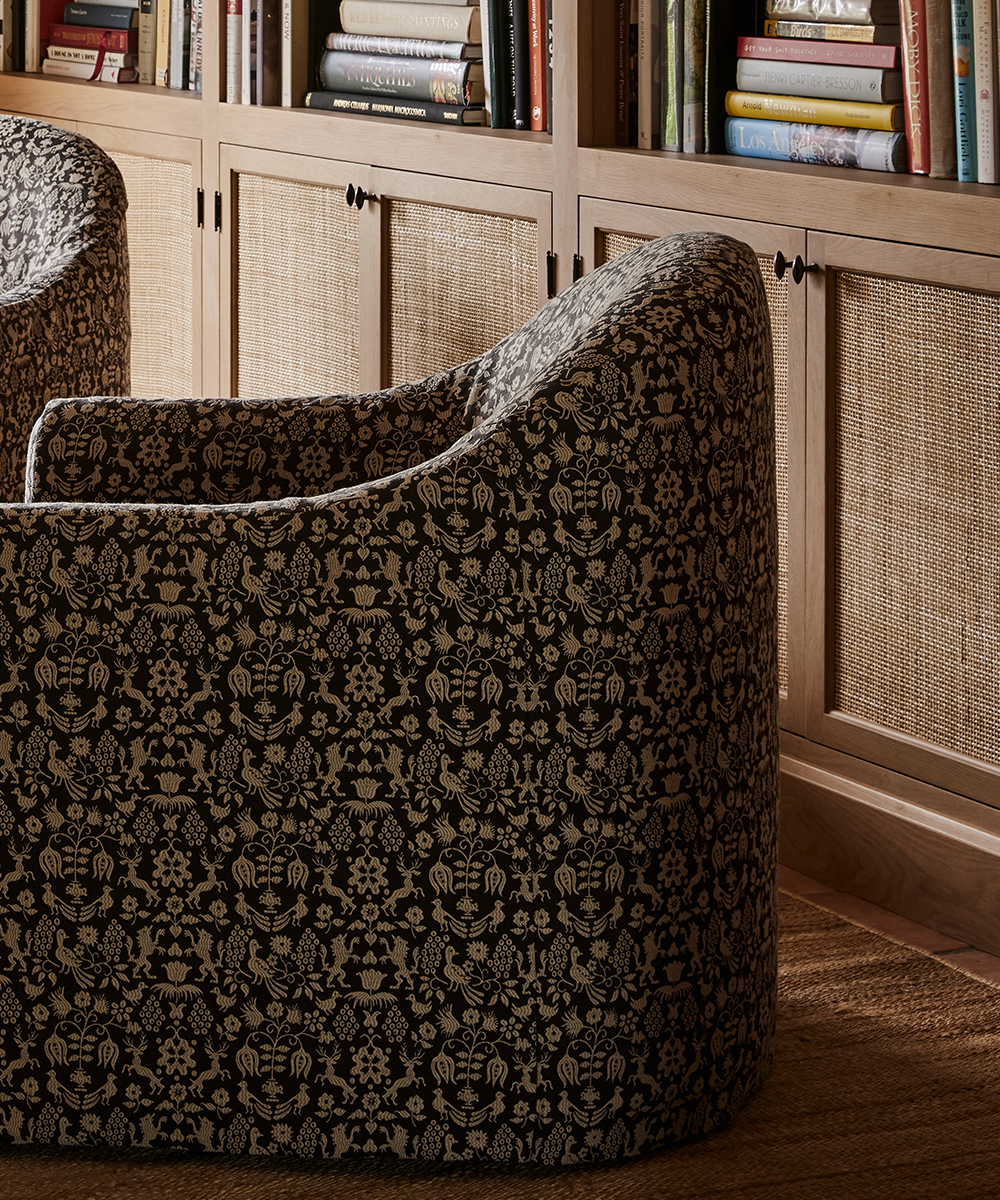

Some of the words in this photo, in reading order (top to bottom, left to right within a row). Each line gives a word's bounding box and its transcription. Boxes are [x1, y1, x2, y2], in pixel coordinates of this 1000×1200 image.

[791, 25, 813, 37] Birds
[908, 9, 920, 75] MOBY
[344, 63, 416, 88] ANTIQUITIES
[764, 72, 787, 84] HENRI
[789, 74, 862, 90] CARTIER-BRESSON
[743, 101, 762, 110] Arnold
[764, 99, 816, 119] Newman
[910, 82, 922, 137] DICK
[958, 82, 966, 110] Lori
[738, 126, 765, 149] Los
[768, 130, 824, 156] Angeles
[959, 112, 969, 162] Gottlieb
